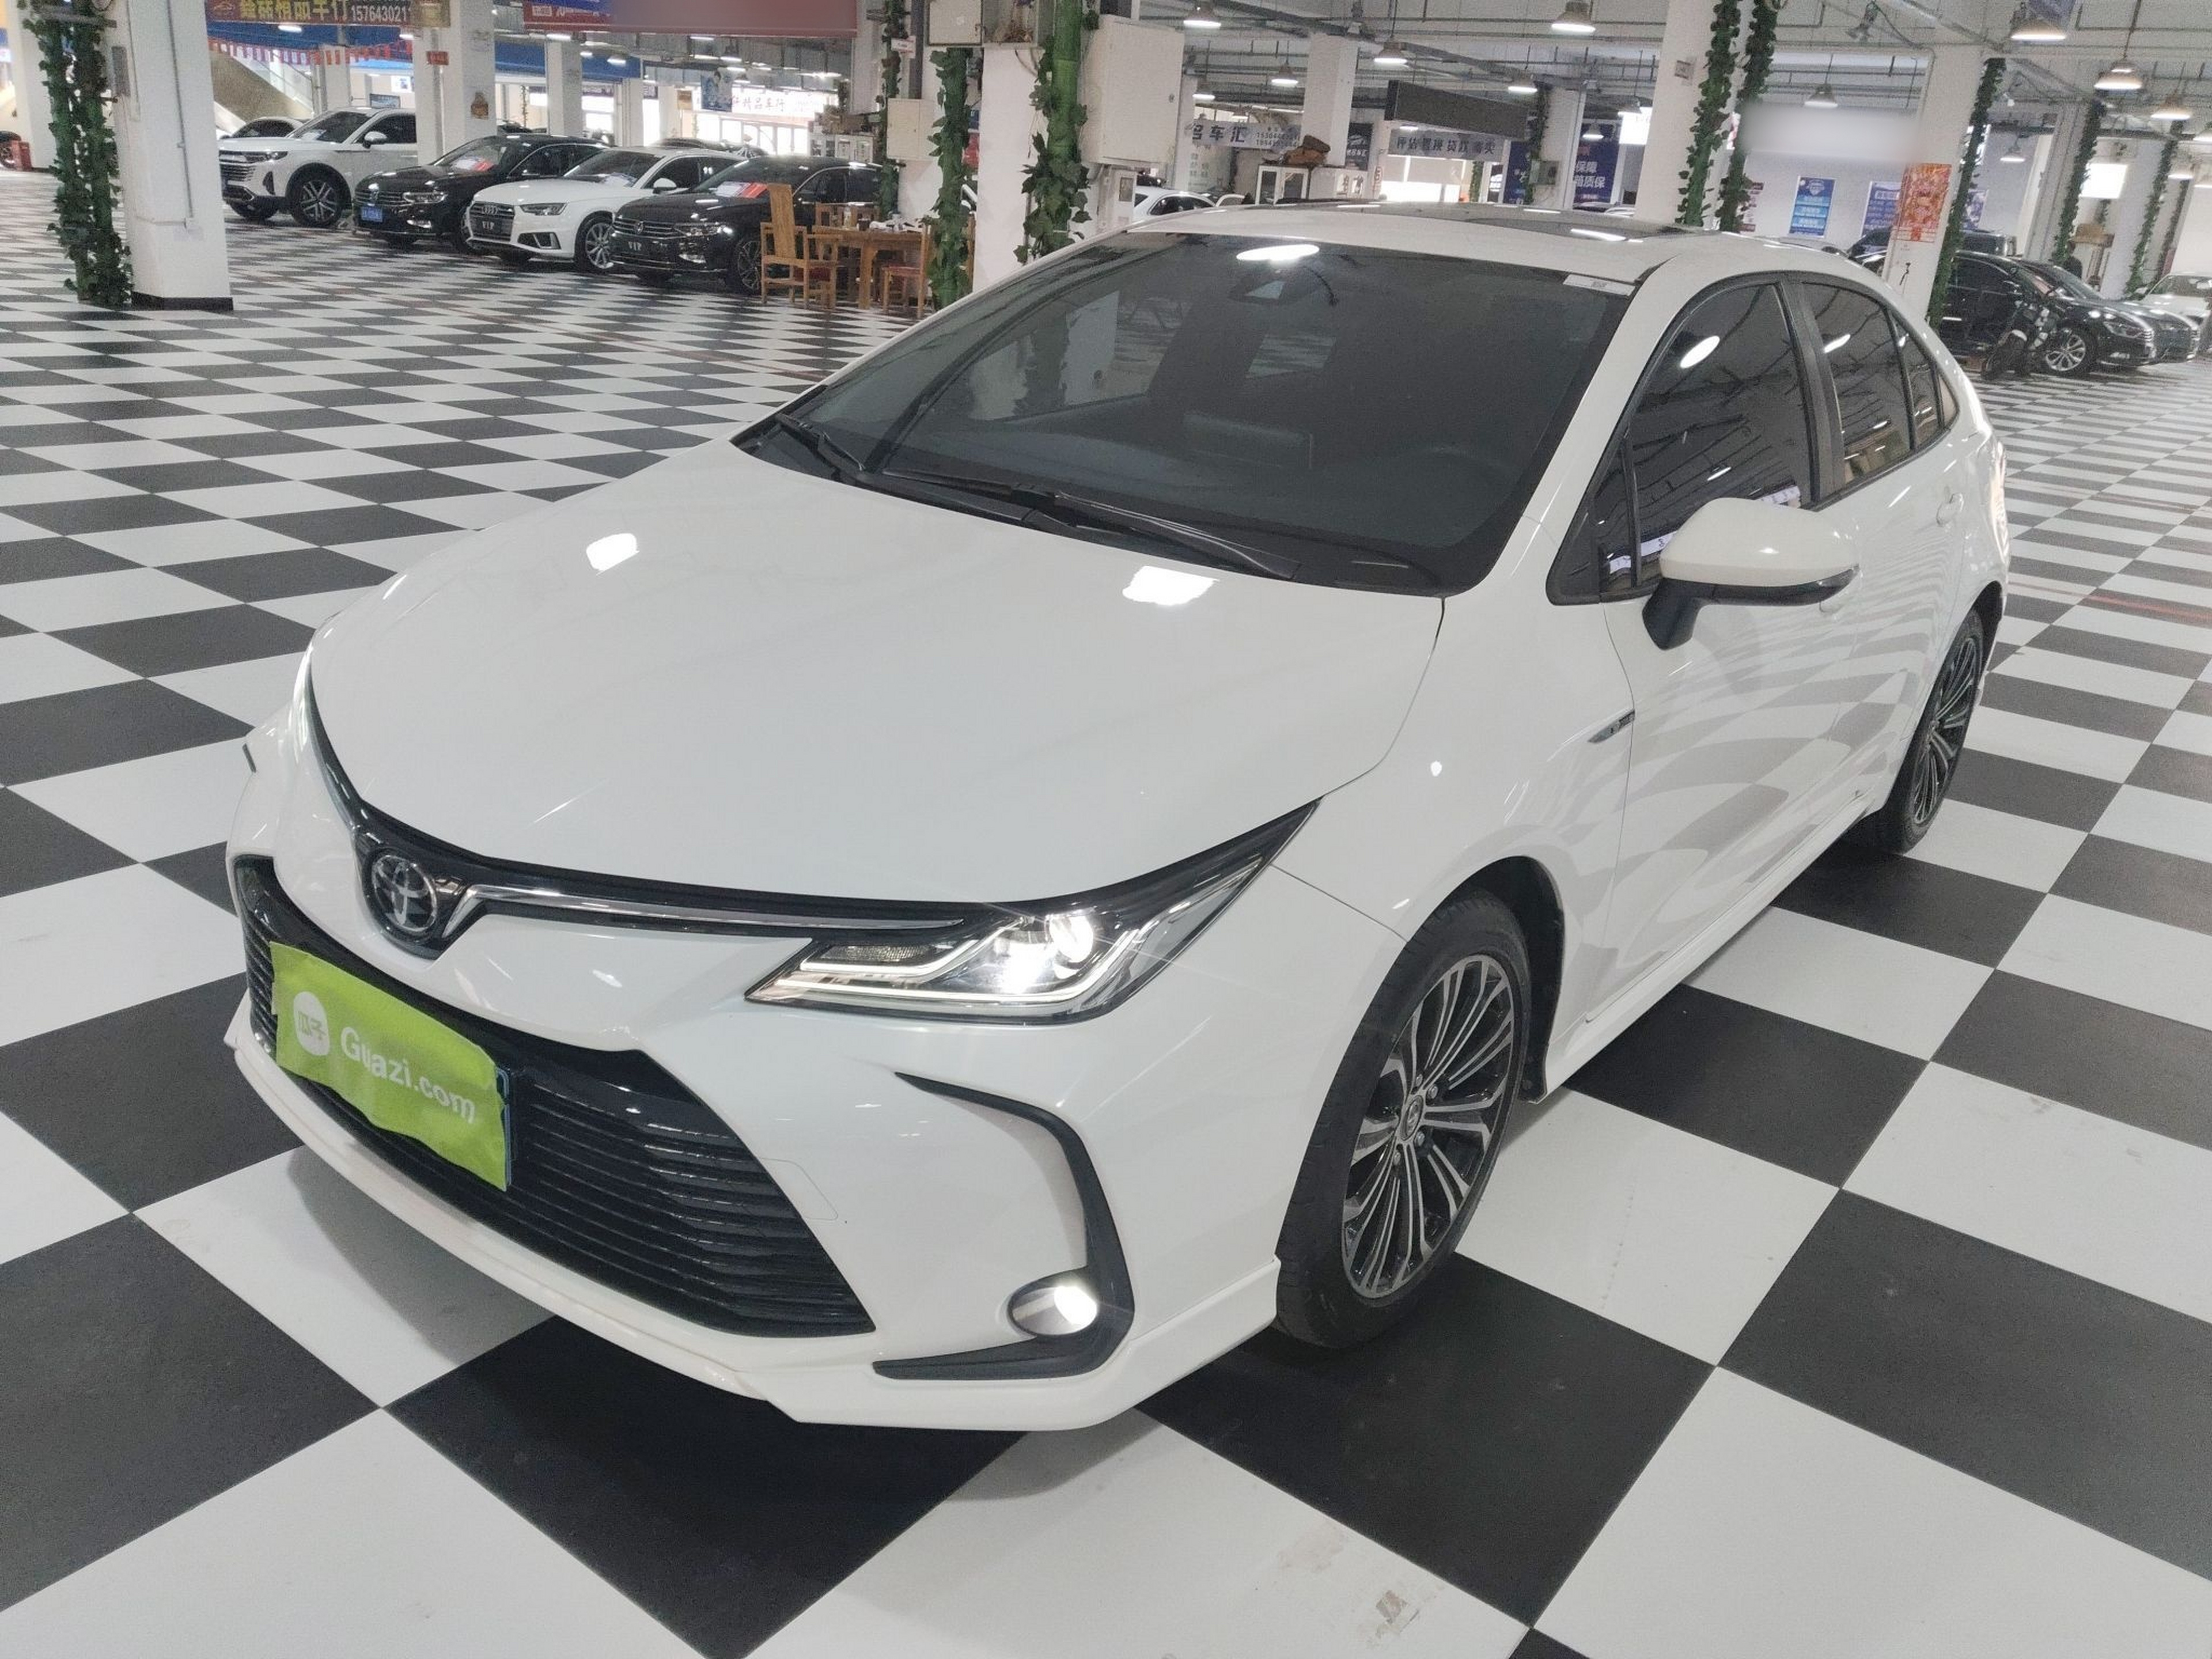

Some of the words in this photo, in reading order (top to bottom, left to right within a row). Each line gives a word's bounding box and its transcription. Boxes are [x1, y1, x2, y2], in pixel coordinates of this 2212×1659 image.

[351, 5, 411, 22] 157643021
[482, 221, 495, 230] VIP
[628, 241, 642, 251] VIP
[341, 1027, 475, 1123] Guazi.com
